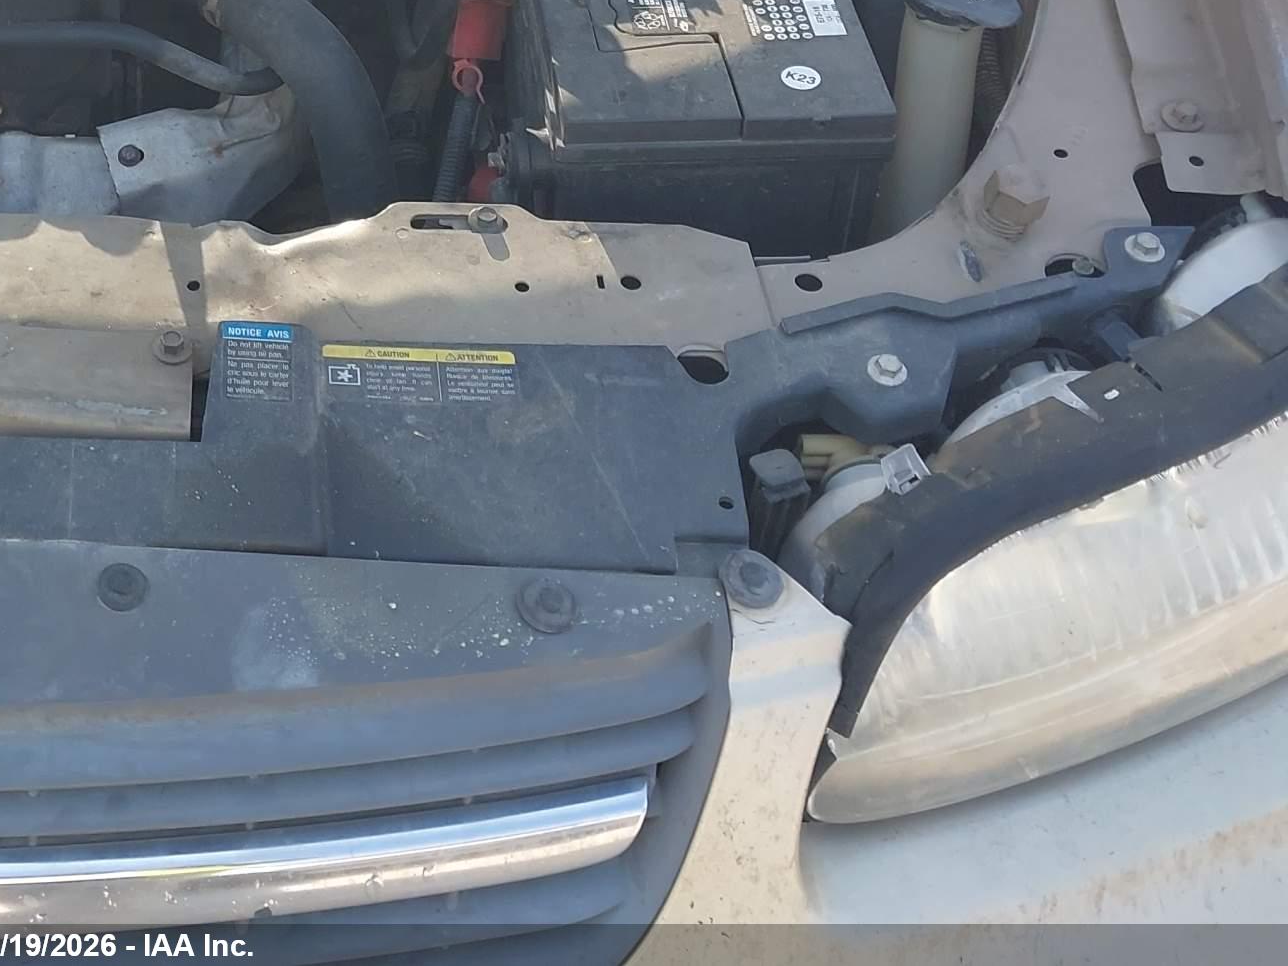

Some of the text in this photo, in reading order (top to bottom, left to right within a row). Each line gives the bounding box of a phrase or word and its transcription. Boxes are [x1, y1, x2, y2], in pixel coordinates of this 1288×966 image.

[785, 71, 816, 85] K23
[228, 327, 289, 338] NOTICE AVIS
